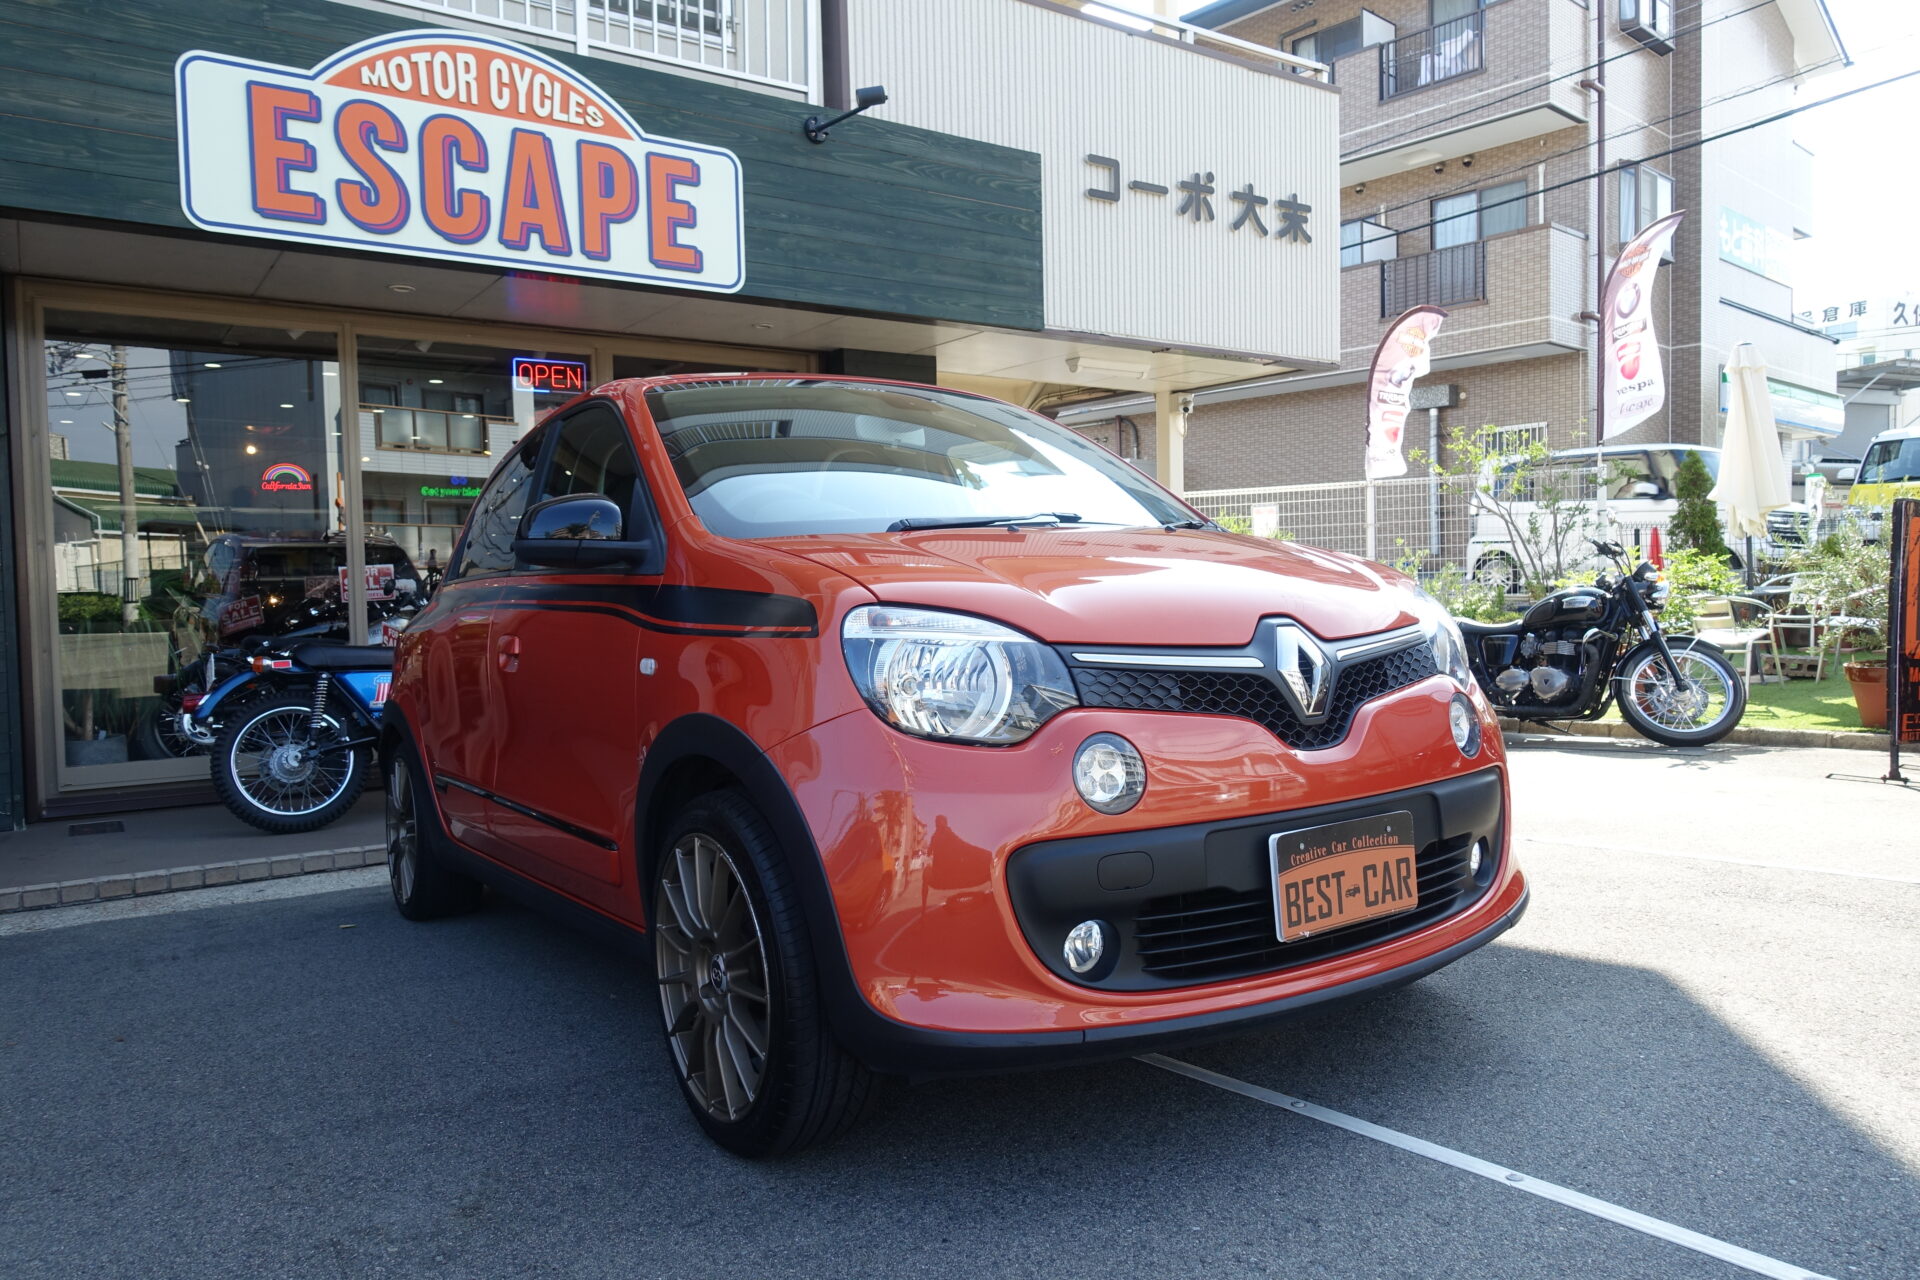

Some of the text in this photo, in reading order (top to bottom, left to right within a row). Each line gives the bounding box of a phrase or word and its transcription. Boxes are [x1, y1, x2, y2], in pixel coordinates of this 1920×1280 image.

[360, 51, 604, 128] MOTOR CYCLES
[246, 79, 704, 274] ESCAPE
[518, 363, 582, 389] OPEN
[222, 605, 260, 624] SALE
[228, 601, 248, 611] FOR
[1290, 833, 1399, 866] Creative Car Collection
[1285, 857, 1413, 928] BEST CAR
